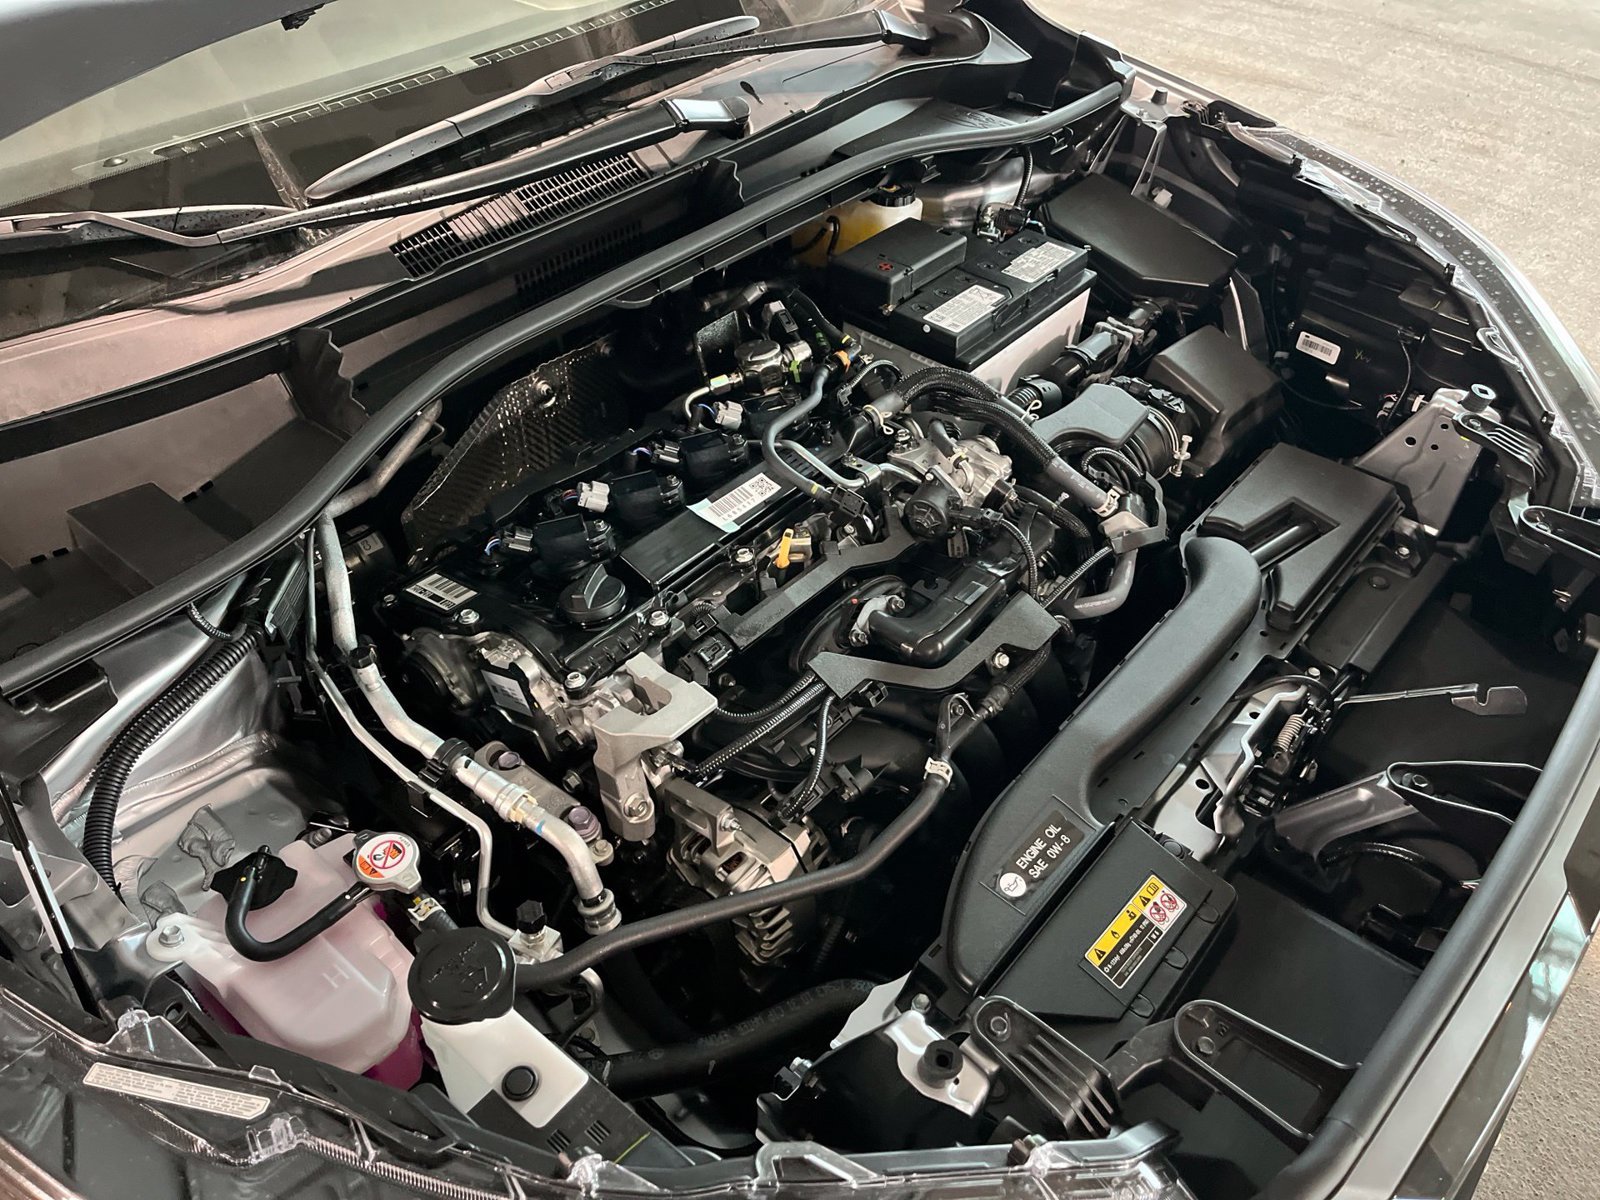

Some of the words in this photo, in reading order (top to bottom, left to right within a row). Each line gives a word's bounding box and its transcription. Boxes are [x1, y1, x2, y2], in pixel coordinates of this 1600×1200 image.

[1016, 838, 1047, 869] ENGINE
[1045, 824, 1062, 839] OIL
[1028, 858, 1049, 879] SAE
[1046, 834, 1071, 859] 0W-8
[322, 963, 349, 988] H
